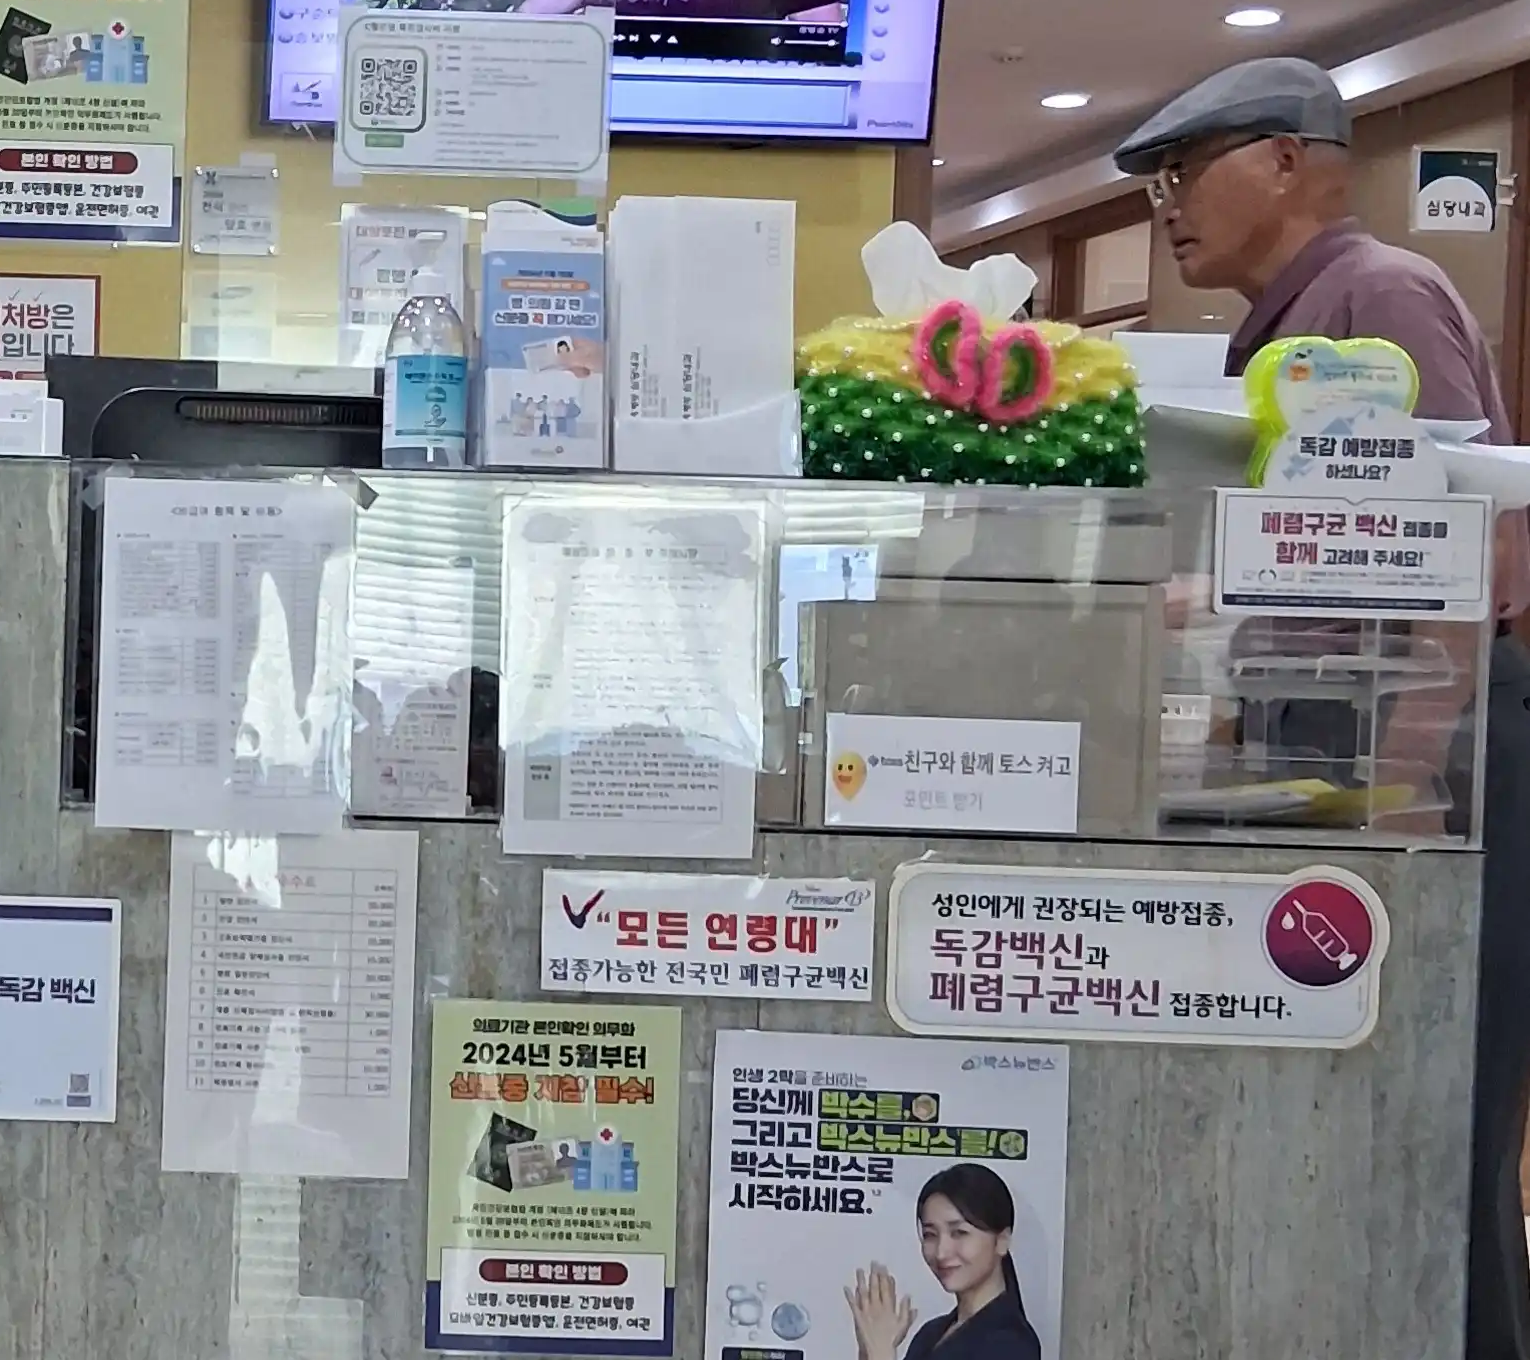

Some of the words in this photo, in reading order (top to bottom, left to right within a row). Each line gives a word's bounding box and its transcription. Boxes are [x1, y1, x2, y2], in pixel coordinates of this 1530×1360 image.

[22, 154, 49, 168] 본인
[53, 155, 81, 168] 확인
[84, 155, 114, 170] 방법
[1427, 198, 1486, 219] 심당내과
[1300, 437, 1336, 458] 독감
[1342, 438, 1415, 460] 예방접종
[1326, 464, 1391, 481] 하셨나요?
[1261, 511, 1347, 538] 폐렴구균
[1355, 513, 1397, 538] 백신
[1275, 541, 1317, 566] 함께
[1323, 549, 1369, 568] 고려해
[1373, 549, 1423, 568] 주세요!
[905, 750, 956, 774] 친구와
[960, 752, 993, 774] 함께
[999, 754, 1032, 774] 토스
[1037, 756, 1071, 776] 켜고
[904, 790, 948, 809] 포인트
[932, 893, 1024, 919] 성인에게
[1032, 898, 1126, 922] 권장되는
[1132, 900, 1233, 928] 예방접종,
[930, 929, 1110, 970] 독감백신과
[548, 958, 656, 983] 접종가능한
[666, 961, 729, 985] 전국민
[739, 964, 869, 990] 폐렴구균백신
[50, 978, 96, 1004] 백신
[929, 972, 1160, 1016] 폐렴구균백신
[1170, 993, 1292, 1019] 접종합니다.
[472, 1019, 530, 1034] 의료기관
[533, 1021, 590, 1035] 본인확인
[593, 1022, 635, 1037] 의무화
[462, 1043, 551, 1066] 2024년
[559, 1045, 647, 1069] 5월부터
[450, 1072, 529, 1100] 신분증
[594, 1077, 655, 1104] 필수!
[733, 1068, 764, 1083] 인생
[768, 1070, 807, 1085] 2막을
[732, 1088, 813, 1116] 당신께
[820, 1091, 910, 1120] 박수를,
[731, 1120, 813, 1148] 그리고
[730, 1151, 894, 1184] 박스뉴반스로
[728, 1185, 872, 1215] 시작하세요.
[506, 1263, 534, 1279] 본인
[539, 1264, 568, 1280] 확인
[627, 1317, 651, 1330] 여권
